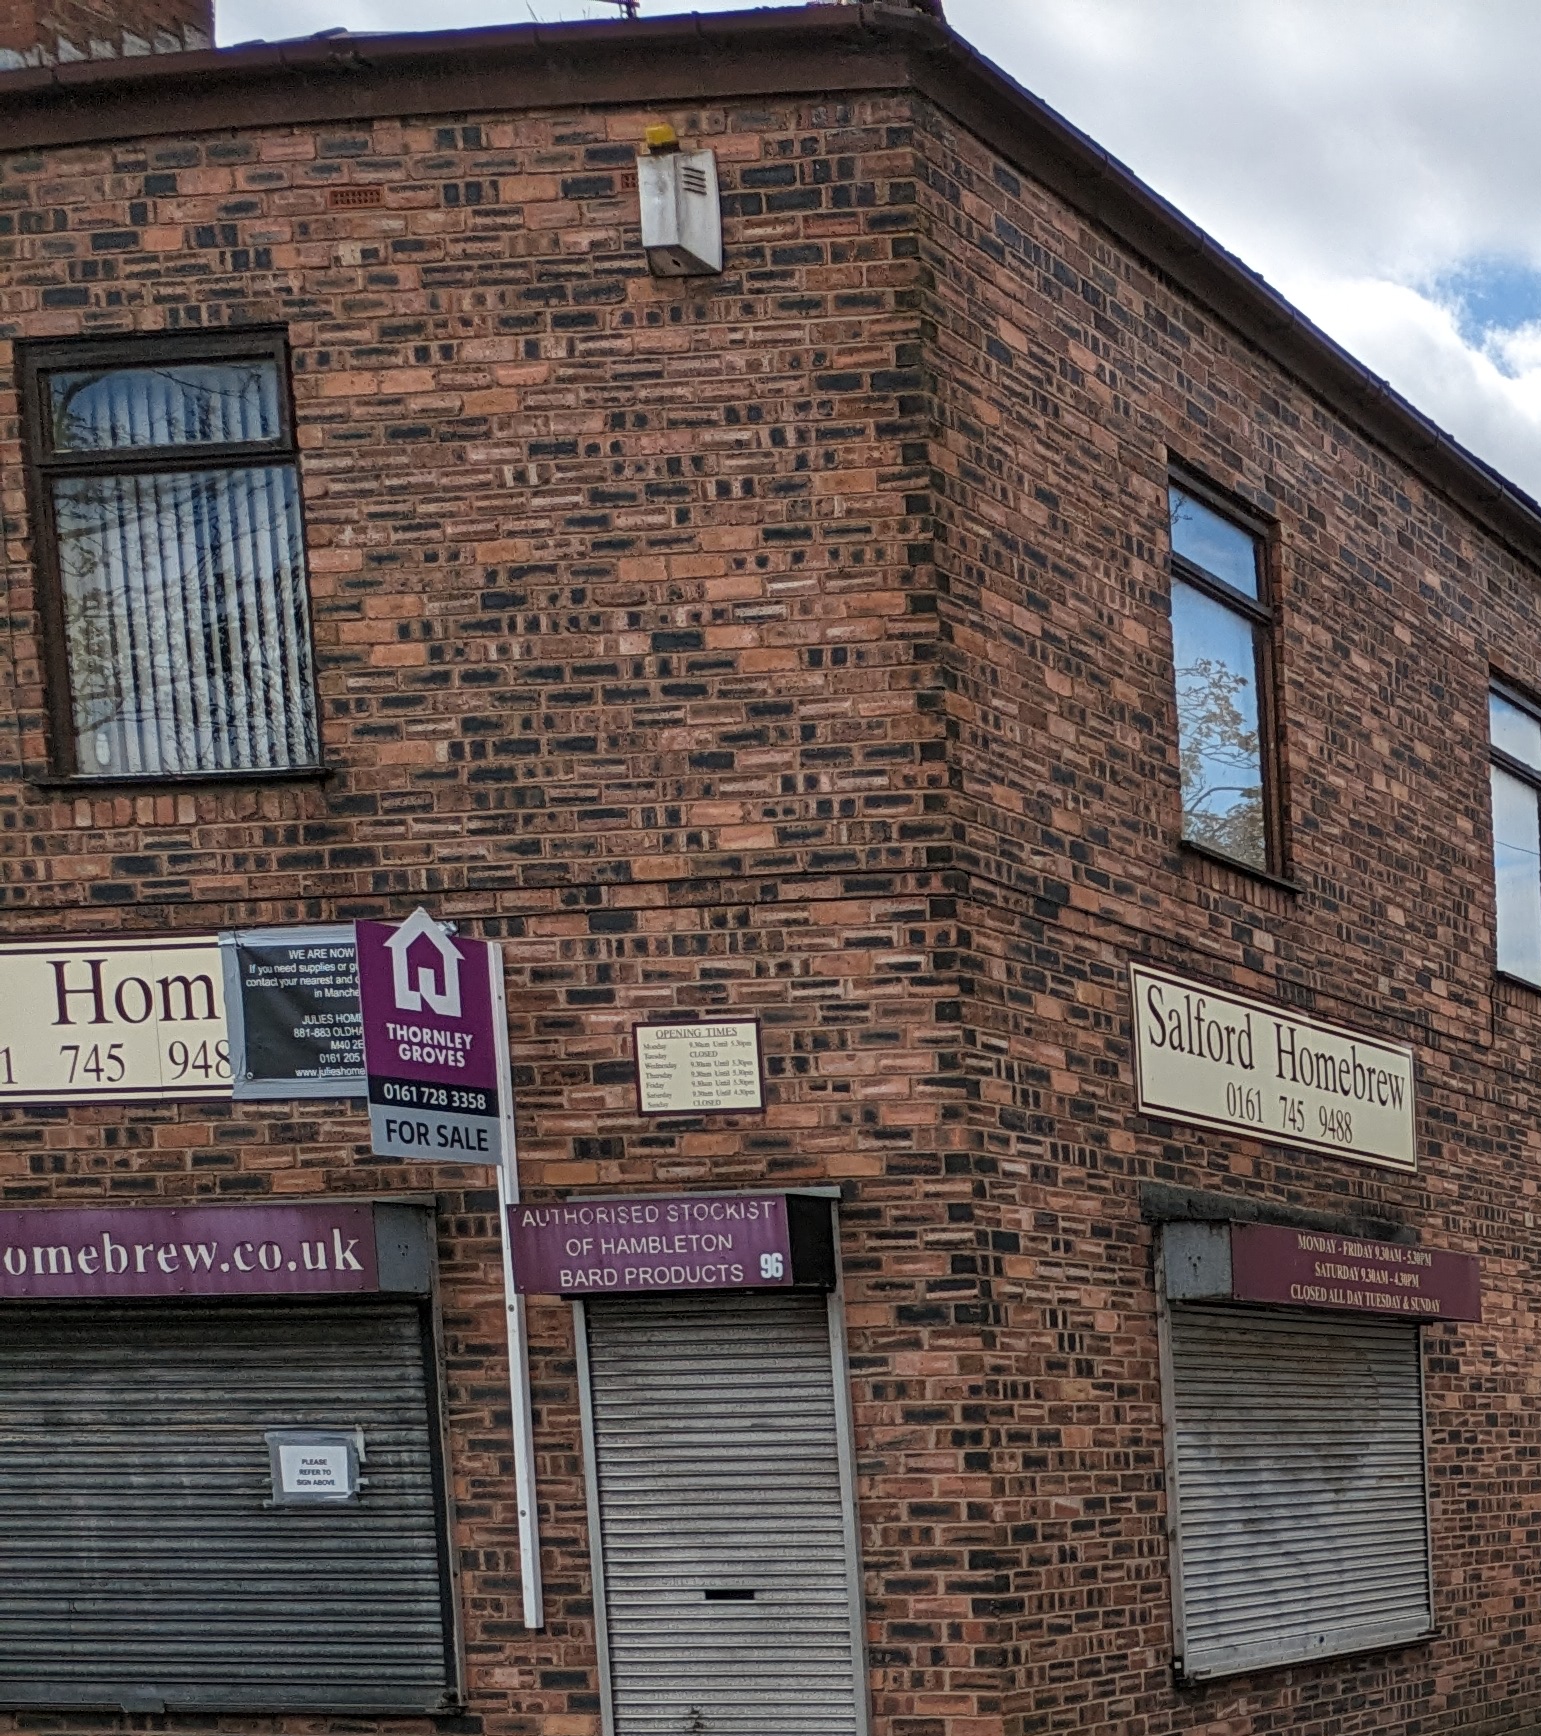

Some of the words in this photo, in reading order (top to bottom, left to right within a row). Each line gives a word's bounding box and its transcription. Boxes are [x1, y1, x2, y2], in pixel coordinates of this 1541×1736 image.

[289, 949, 305, 960] WE
[307, 948, 327, 959] ARE
[330, 947, 354, 958] NOW
[249, 964, 256, 973] If
[258, 965, 272, 976] you
[274, 964, 296, 973] need
[299, 962, 335, 974] supplies
[338, 963, 346, 971] or
[246, 978, 279, 987] contact
[280, 978, 297, 988] your
[300, 976, 333, 985] nearest
[336, 974, 352, 983] and
[314, 988, 322, 998] in
[302, 1013, 333, 1024] JULIES
[293, 1027, 331, 1038] 881-883
[385, 1022, 473, 1050] THORNLEY
[655, 1028, 701, 1039] OPENING
[706, 1026, 738, 1037] TIMES
[330, 1040, 350, 1050] M40
[399, 1043, 466, 1068] GROVES
[689, 1050, 718, 1058] CLOSED
[1147, 983, 1255, 1071] Salford
[1273, 1022, 1405, 1112] Homebrew
[60, 1043, 125, 1083] 745
[319, 1053, 340, 1063] 0161
[343, 1052, 360, 1062] 205
[383, 1083, 417, 1102] 0161
[420, 1087, 448, 1106] 728
[451, 1091, 487, 1110] 3358
[1226, 1081, 1264, 1124] 0161
[1279, 1095, 1304, 1133] 745
[1318, 1105, 1353, 1144] 9488
[385, 1118, 431, 1146] FOR
[436, 1124, 489, 1152] SALE
[521, 1205, 659, 1228] AUTHORISED
[666, 1201, 775, 1222] STOCKIST
[3, 1228, 364, 1276] omebrew.co.uk
[566, 1238, 594, 1256] OF
[600, 1233, 733, 1255] HAMBLETON
[1297, 1233, 1337, 1254] MONDAY
[1343, 1240, 1374, 1259] FRIDAY
[560, 1268, 618, 1288] BARD
[625, 1264, 743, 1285] PRODUCTS
[760, 1252, 783, 1279] 96
[1315, 1261, 1360, 1282] SATURDAY
[1290, 1283, 1328, 1302] CLOSED
[1329, 1287, 1347, 1304] ALL
[1347, 1289, 1364, 1306] DAY
[1364, 1291, 1402, 1309] TUESDAY
[1402, 1296, 1410, 1310] &
[1411, 1296, 1441, 1313] SUNDAY
[302, 1458, 327, 1466] PLEASE
